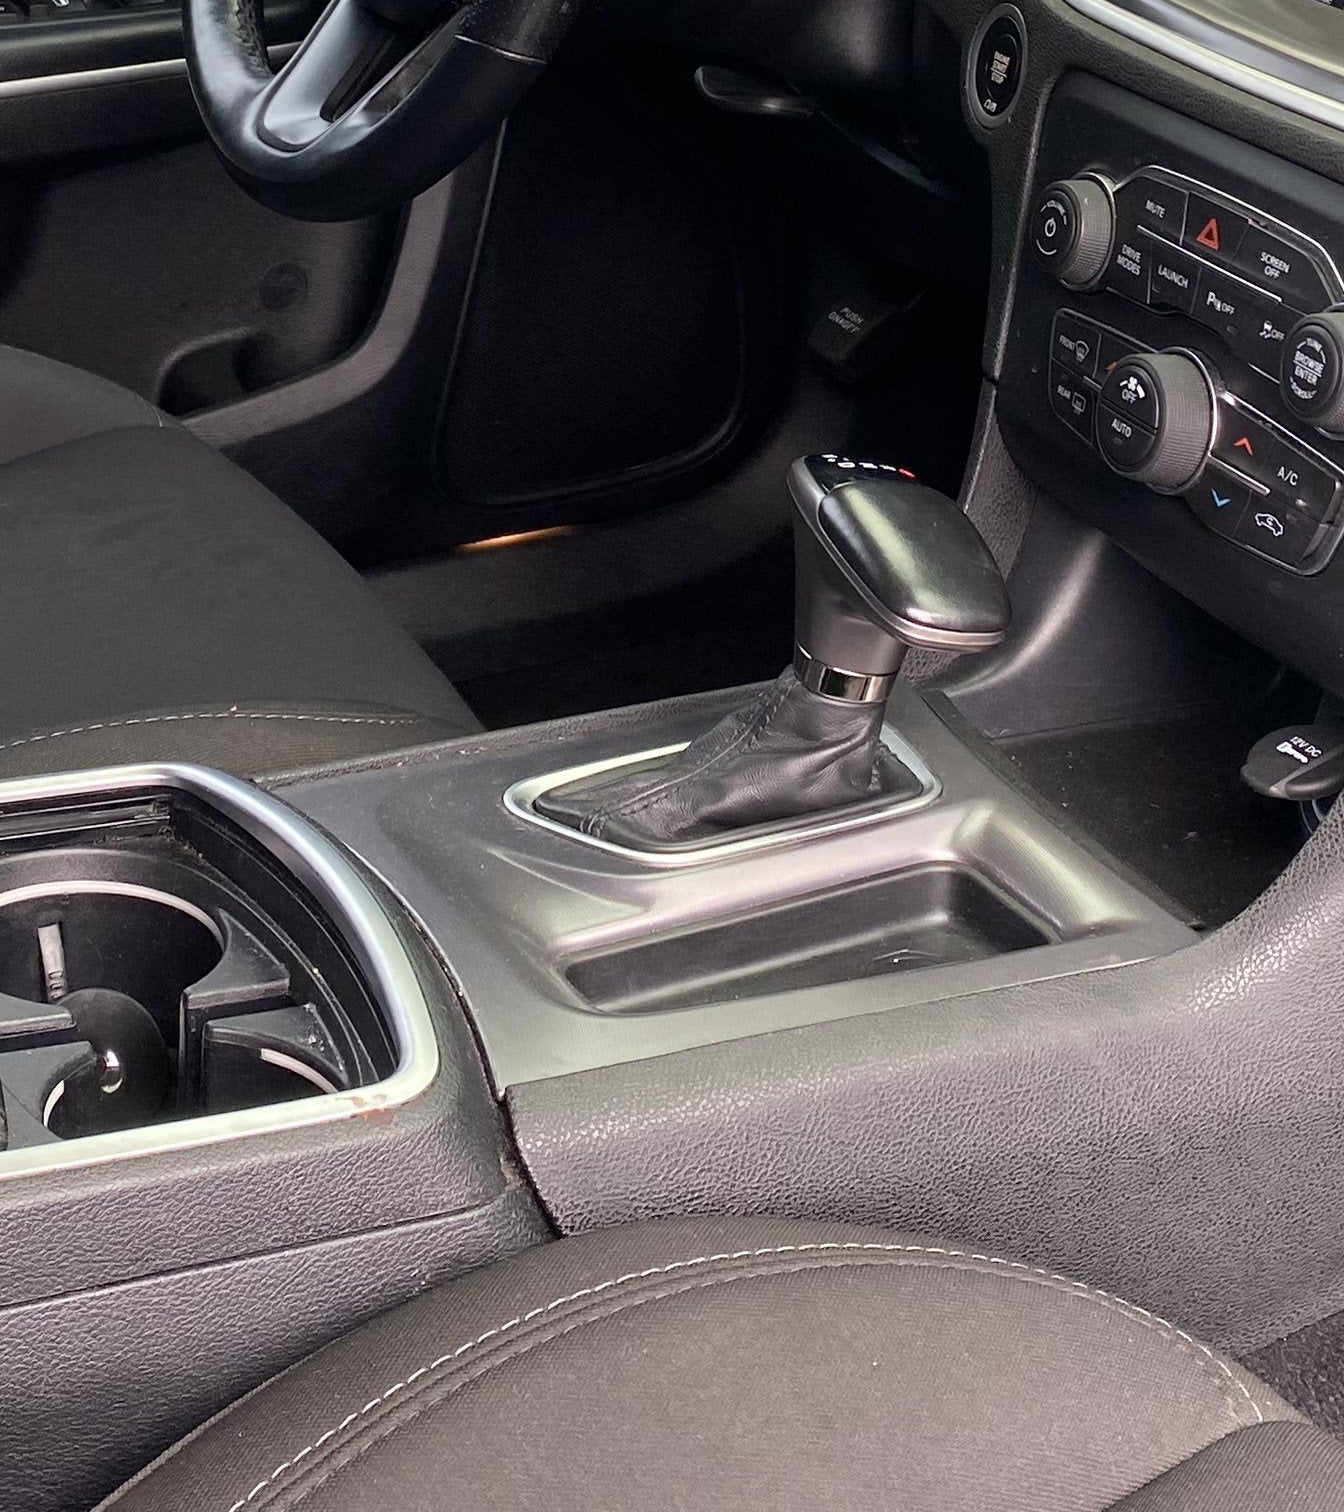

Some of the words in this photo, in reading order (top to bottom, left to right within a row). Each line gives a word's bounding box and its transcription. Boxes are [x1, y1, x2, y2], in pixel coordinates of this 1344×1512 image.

[1145, 199, 1166, 219] MUTE
[1121, 243, 1142, 263] DRIVE
[1260, 251, 1291, 274] SCREEN
[1116, 254, 1142, 276] MODES
[1263, 265, 1281, 280] OFF
[1157, 264, 1189, 289] LAUNCH
[1221, 301, 1236, 315] OFF
[1059, 334, 1076, 351] FRONT
[1271, 328, 1285, 342] OFF
[1294, 350, 1325, 374] BROWSE
[1294, 364, 1319, 386] ENTER
[1057, 384, 1072, 400] REAR
[1121, 388, 1138, 405] OFF
[1111, 417, 1132, 438] AUTO
[1276, 465, 1299, 486] A/C
[1289, 736, 1310, 749] 12V
[1305, 745, 1322, 758] DC
